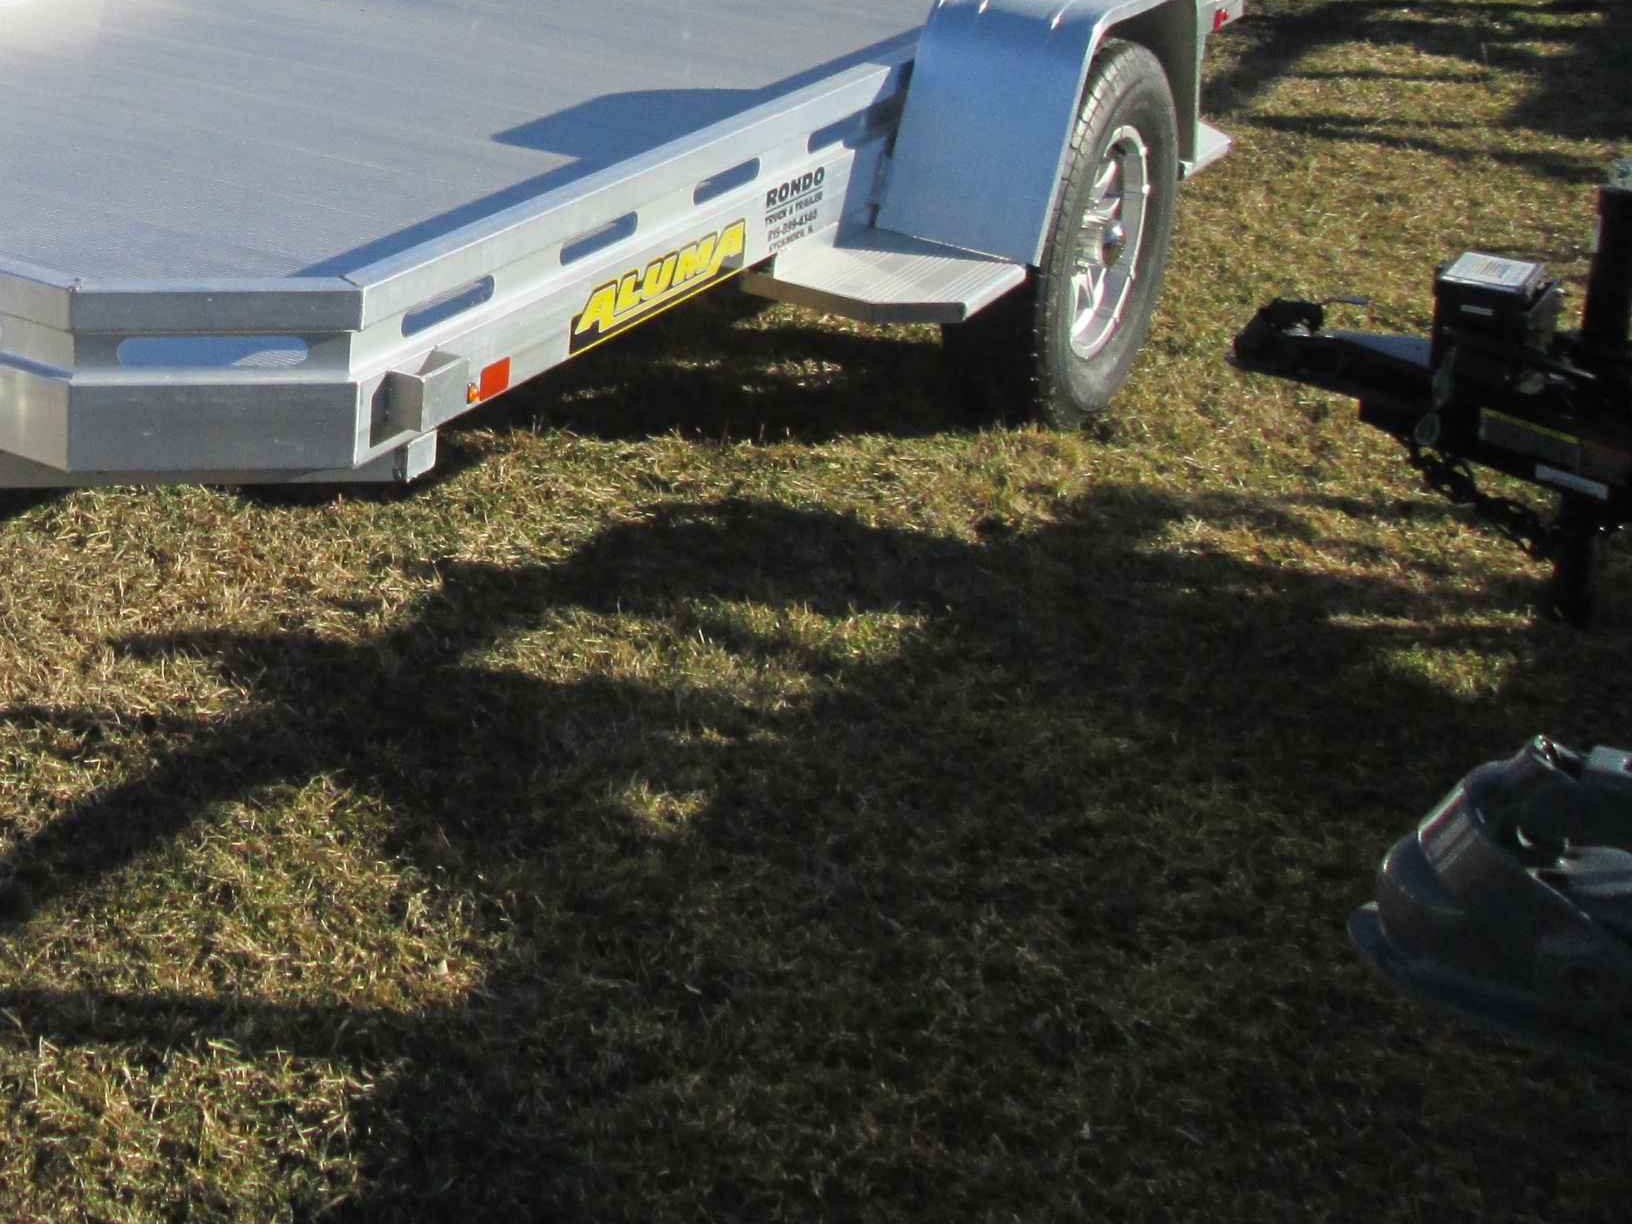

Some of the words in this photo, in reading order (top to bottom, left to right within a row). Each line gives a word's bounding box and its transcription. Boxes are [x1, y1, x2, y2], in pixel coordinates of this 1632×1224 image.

[766, 166, 826, 208] RONDO
[765, 209, 788, 227] TRUCK
[795, 190, 824, 213] TRAILER
[574, 220, 745, 336] ALUMA
